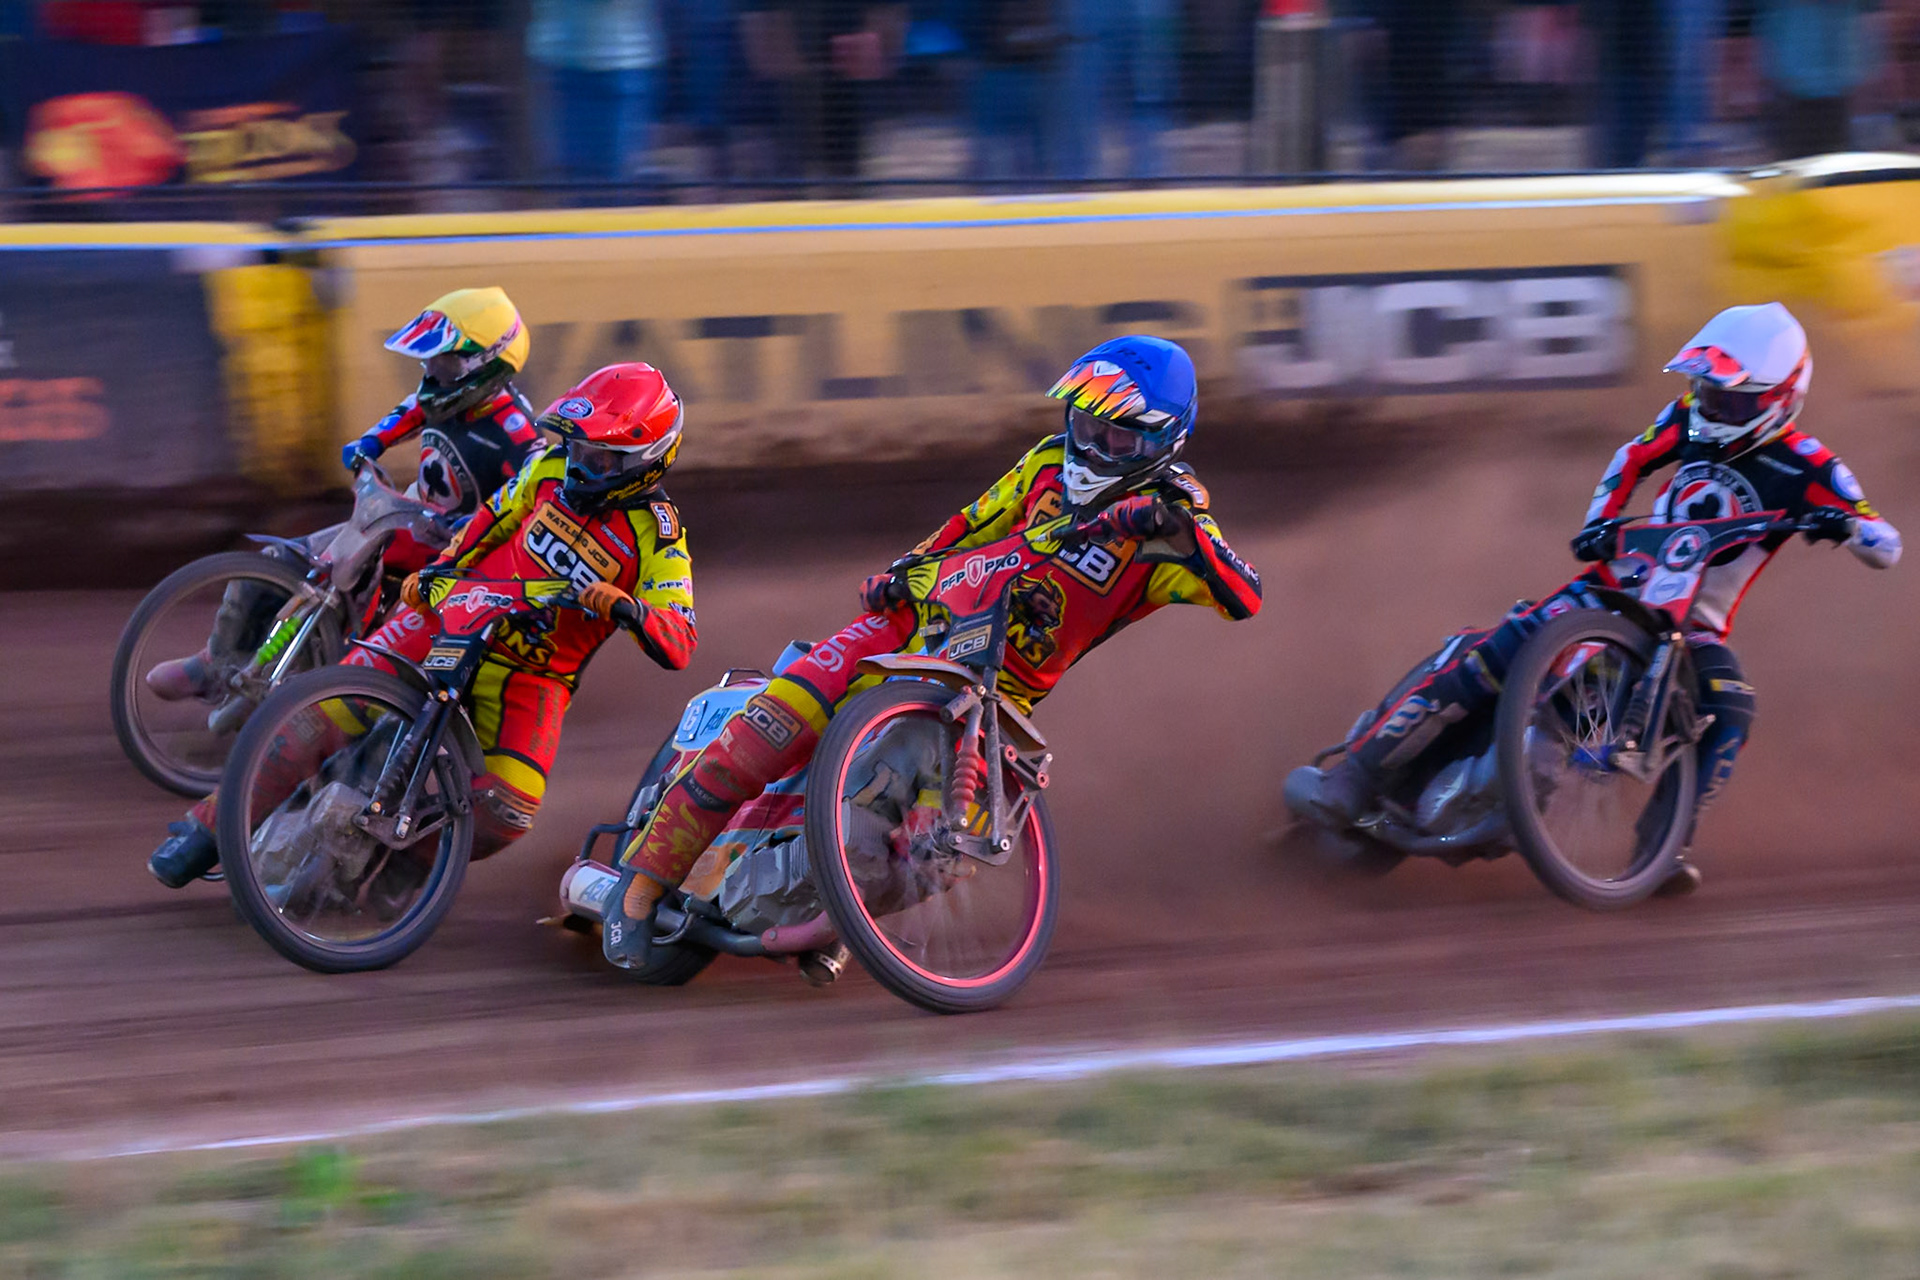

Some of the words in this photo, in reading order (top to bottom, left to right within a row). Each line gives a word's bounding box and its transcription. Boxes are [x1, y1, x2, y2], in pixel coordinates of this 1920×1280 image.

[1238, 277, 1638, 388] JCB
[546, 509, 589, 548] WATLING
[588, 547, 610, 569] JCB
[654, 504, 672, 536] JCB
[527, 532, 600, 595] JCB
[940, 570, 966, 594] PFP
[984, 552, 1020, 574] PRO
[352, 612, 425, 668] gnite
[950, 636, 987, 658] JCB
[425, 656, 457, 668] JCB
[745, 707, 789, 743] JCB
